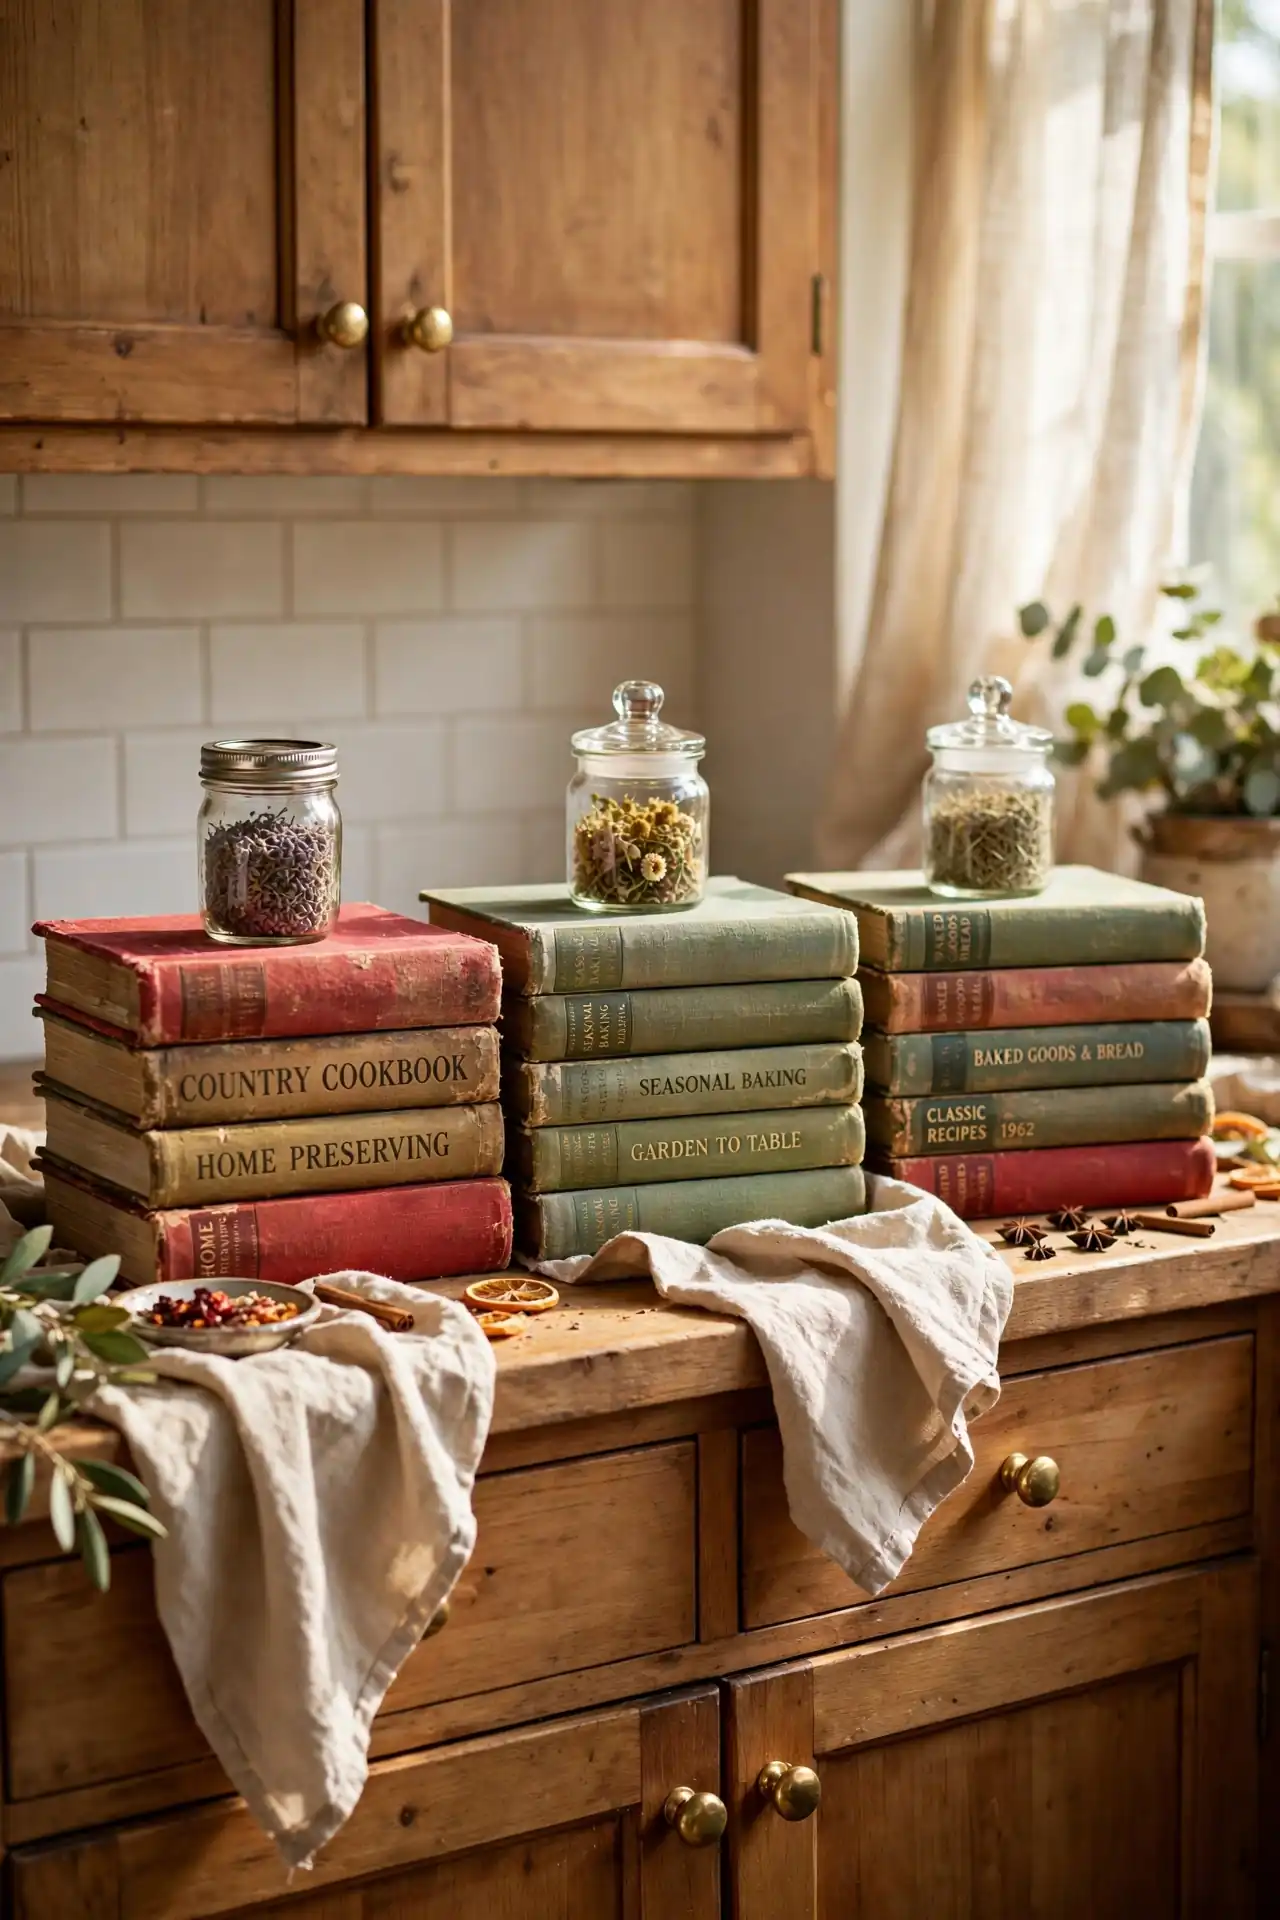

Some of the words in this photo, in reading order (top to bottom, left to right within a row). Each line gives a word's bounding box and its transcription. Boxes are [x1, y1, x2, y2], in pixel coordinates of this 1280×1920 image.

[974, 1046, 1023, 1066] BAKED
[1028, 1045, 1076, 1062] GOODS
[1082, 1047, 1091, 1060] &
[1097, 1042, 1144, 1060] BREAD
[180, 1066, 310, 1103] COUNTRY
[322, 1055, 468, 1090] COOKBOOK
[640, 1073, 734, 1096] SEASONAL
[742, 1069, 807, 1089] BAKING
[927, 1106, 986, 1122] CLASSIC
[632, 1138, 708, 1161] GARDEN
[716, 1136, 740, 1153] TO
[747, 1131, 801, 1151] TABLE
[928, 1124, 986, 1144] RECIPES
[1001, 1122, 1034, 1138] 1962
[197, 1148, 277, 1180] HOME
[290, 1132, 450, 1171] PRESERVING
[198, 1221, 215, 1276] HOME
